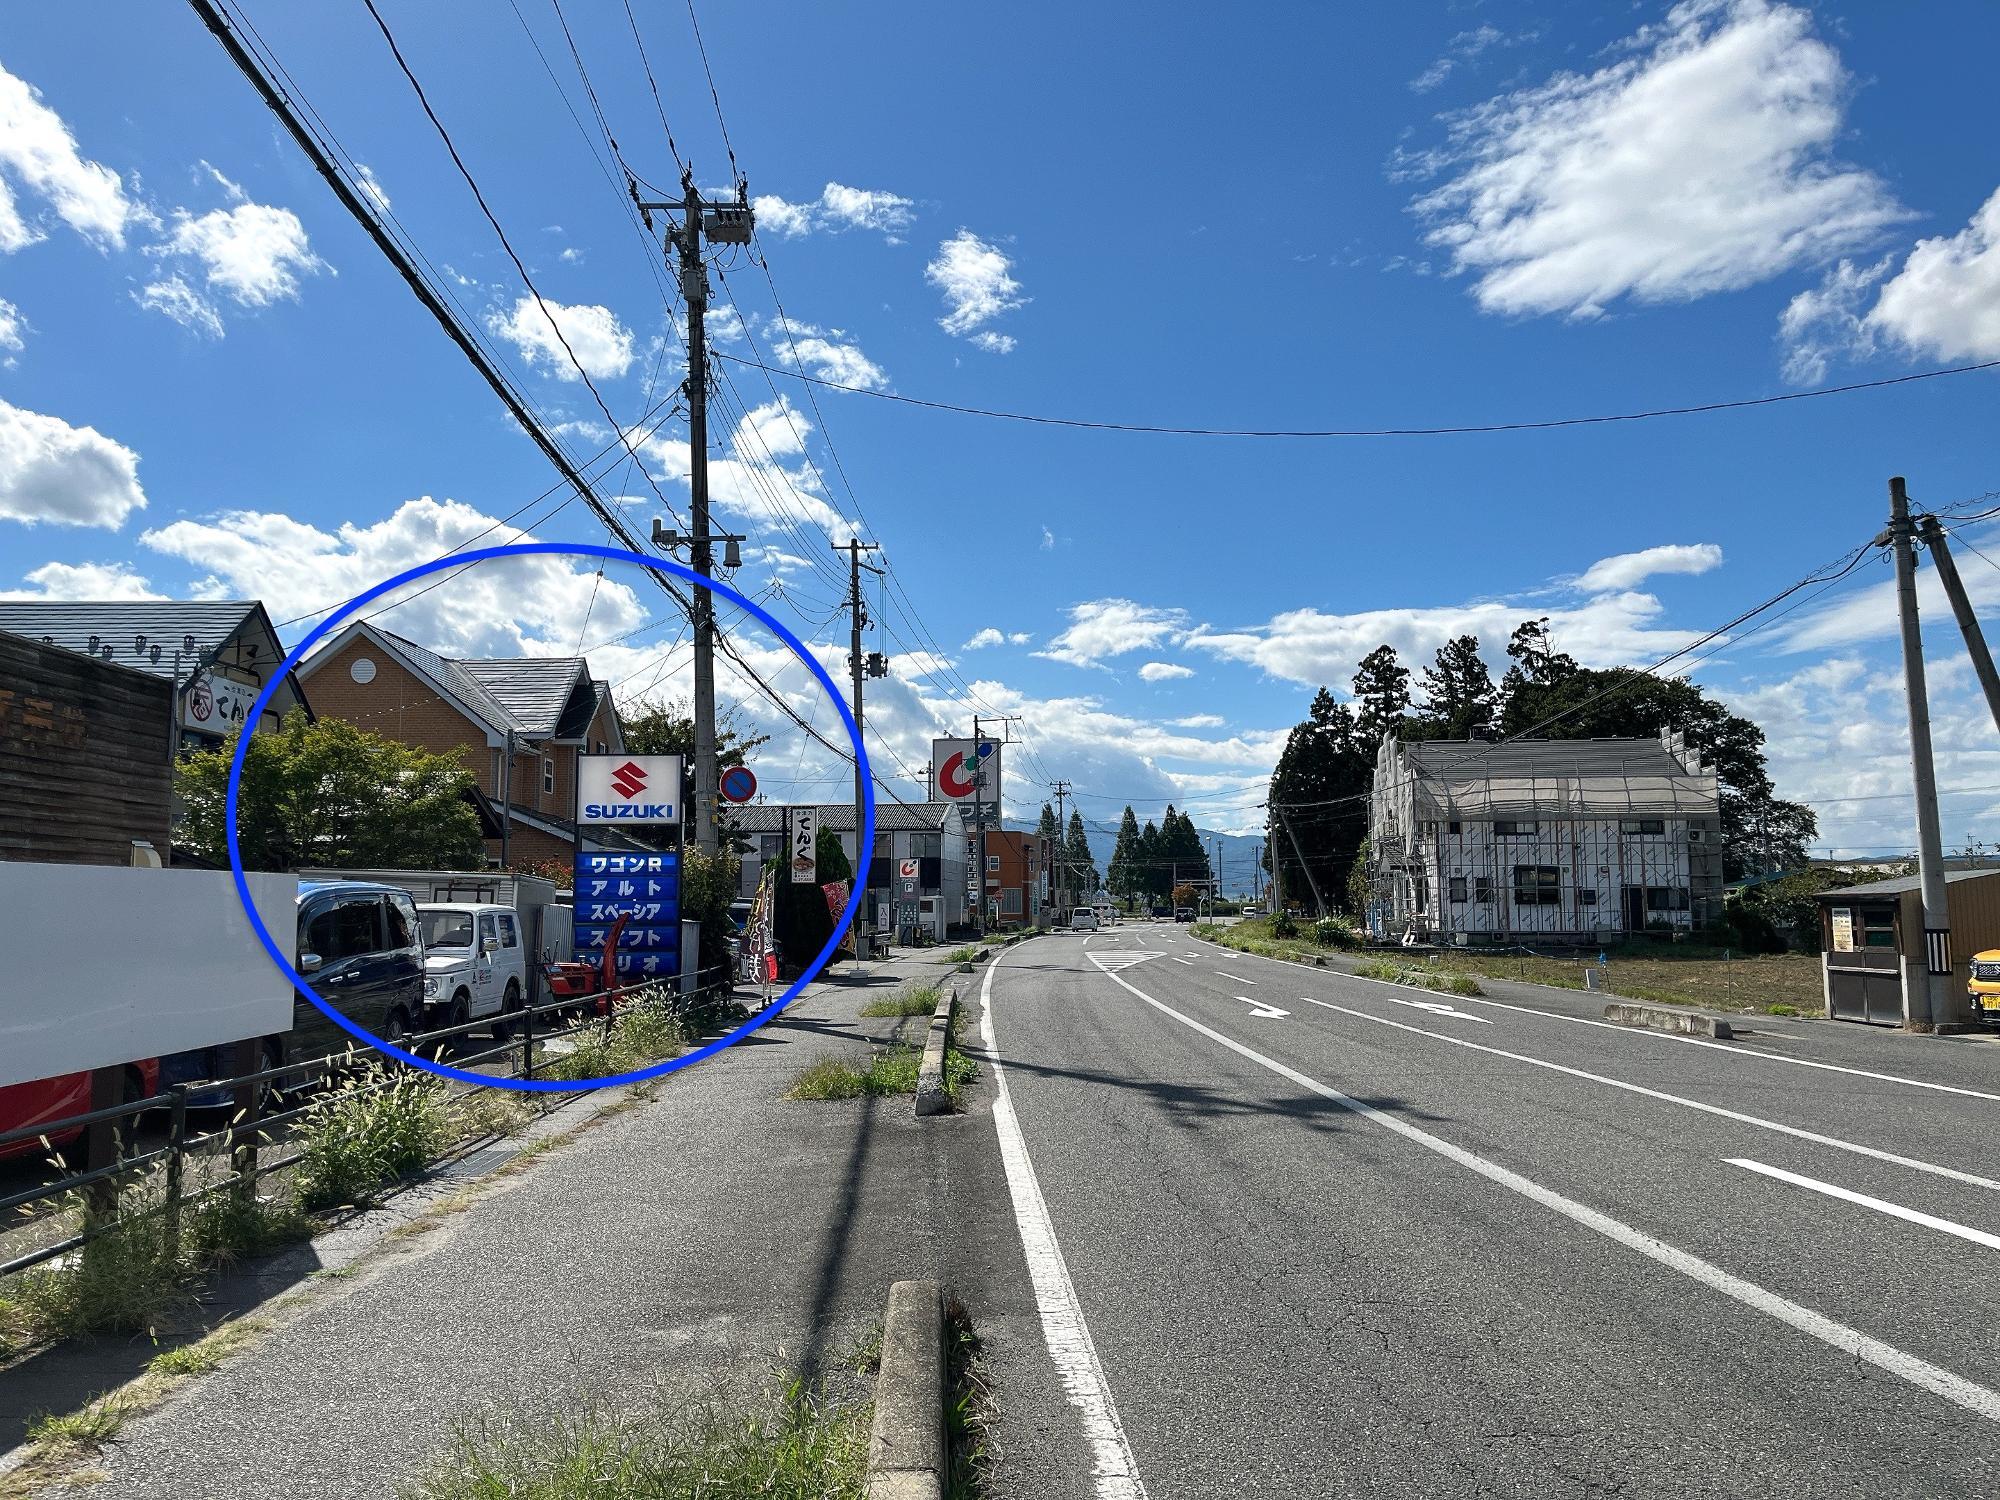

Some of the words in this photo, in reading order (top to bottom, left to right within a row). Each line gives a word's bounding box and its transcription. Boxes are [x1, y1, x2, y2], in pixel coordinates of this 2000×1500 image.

[585, 804, 672, 818] SUZUKI
[957, 803, 993, 817] ワチ
[796, 817, 811, 859] てんぐ
[591, 857, 662, 873] ワゴンR
[591, 880, 661, 896] アルト
[590, 903, 661, 920] スペーシア
[880, 907, 887, 926] 入口
